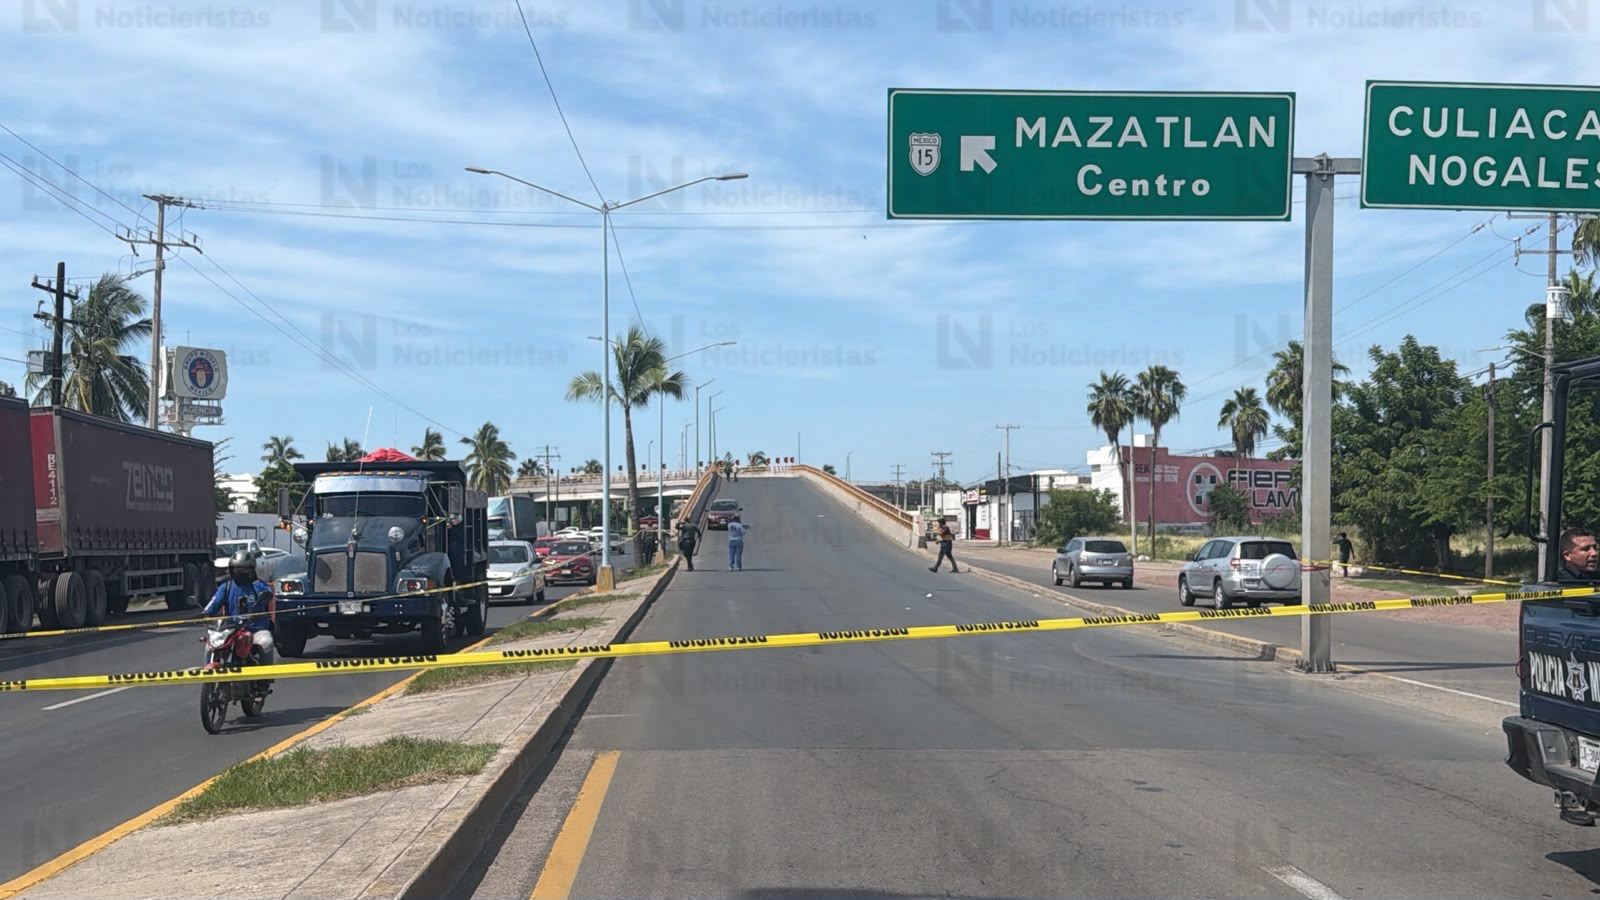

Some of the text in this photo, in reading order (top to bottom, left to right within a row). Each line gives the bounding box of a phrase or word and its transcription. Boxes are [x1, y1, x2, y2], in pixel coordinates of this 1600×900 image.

[1015, 115, 1275, 148] MAZATLAN
[1388, 105, 1600, 141] CULIACA
[918, 149, 933, 166] 15
[1077, 164, 1210, 196] Centro
[183, 406, 217, 415] AGENCIA
[1528, 651, 1567, 697] POLICIA
